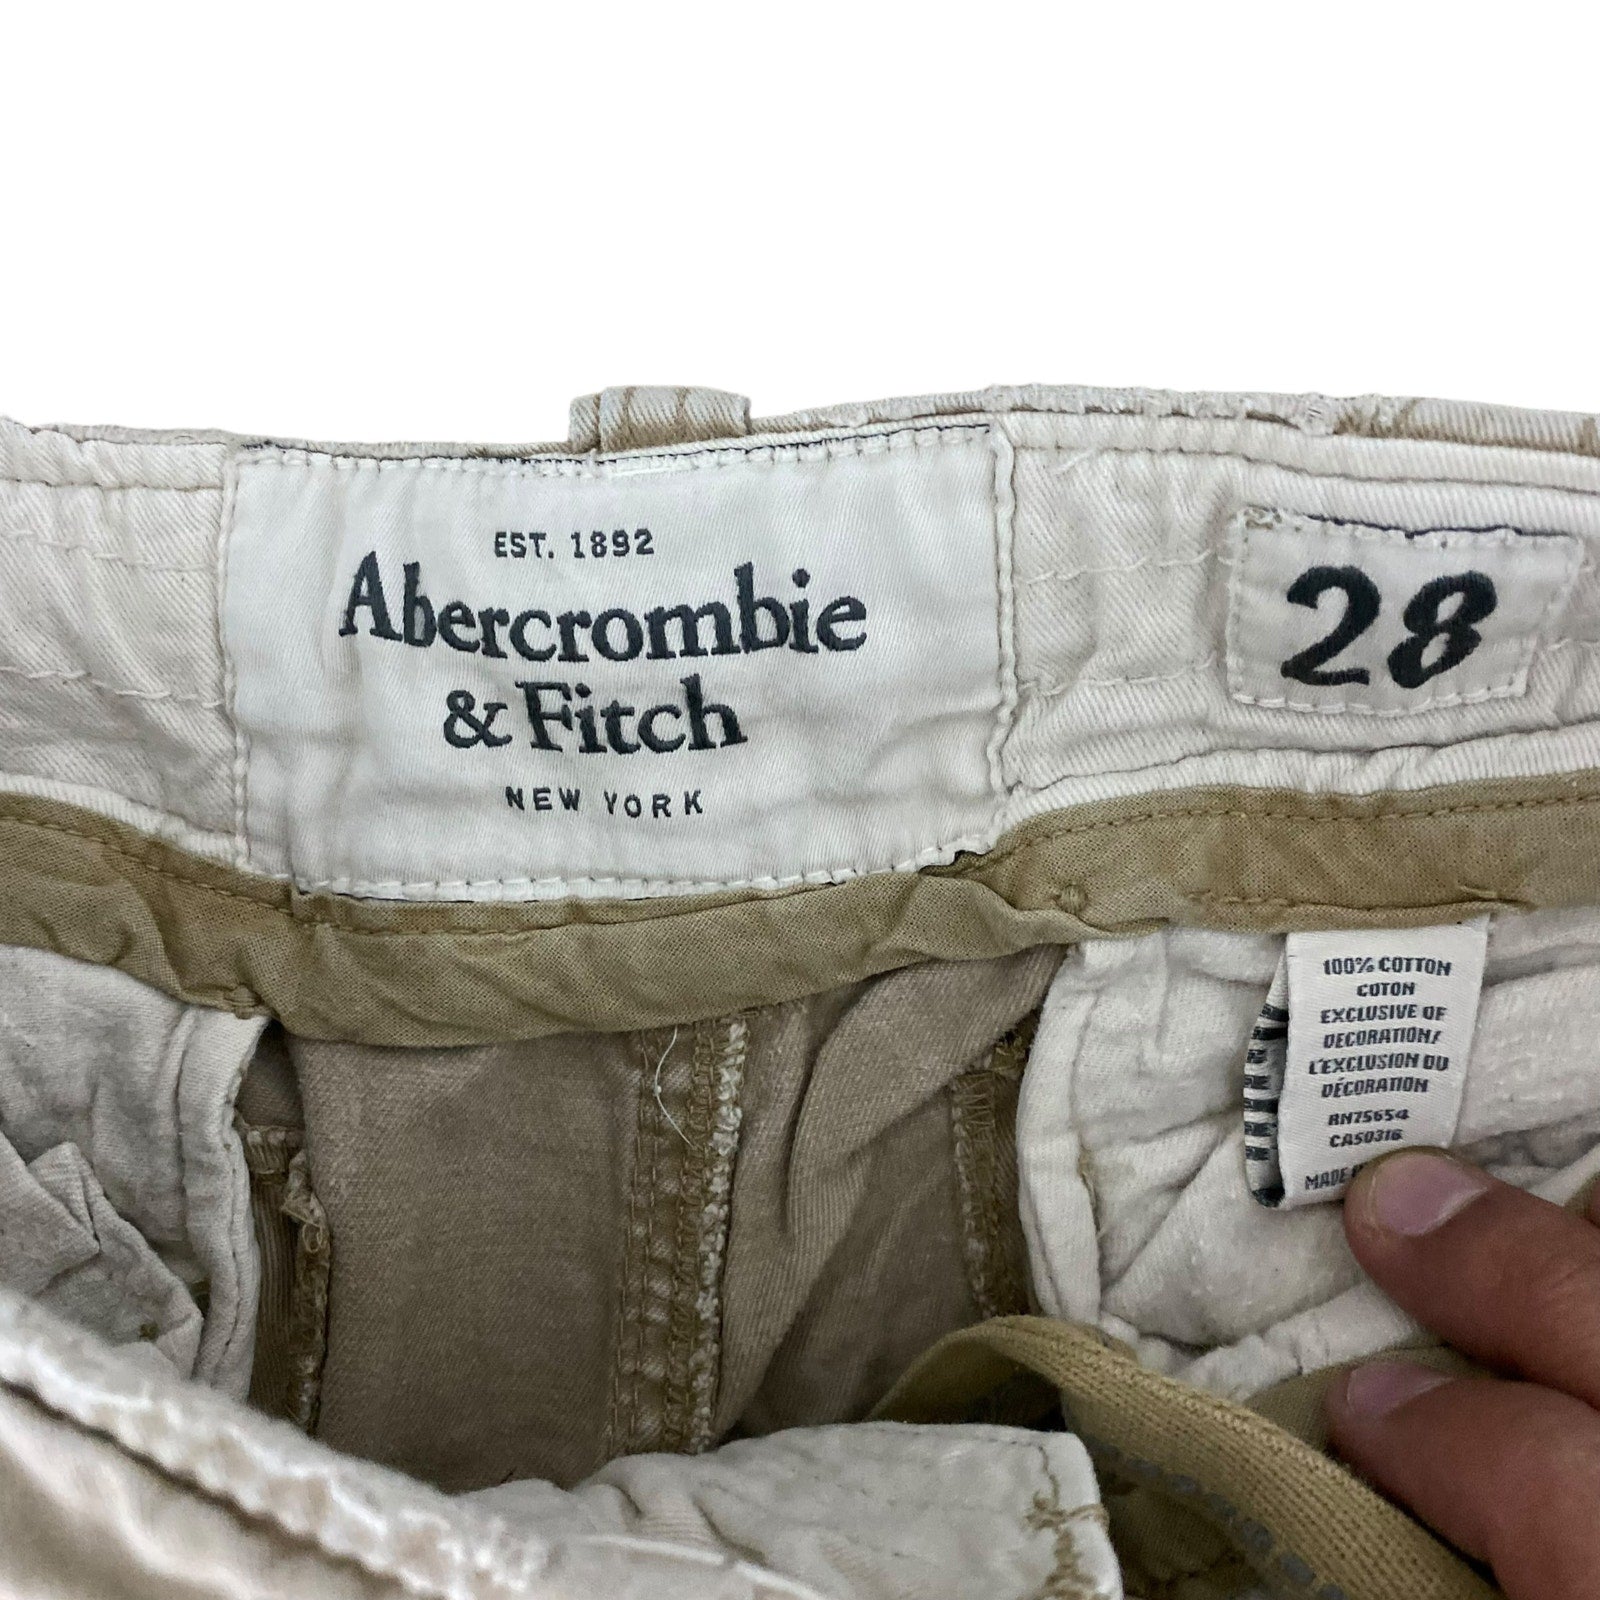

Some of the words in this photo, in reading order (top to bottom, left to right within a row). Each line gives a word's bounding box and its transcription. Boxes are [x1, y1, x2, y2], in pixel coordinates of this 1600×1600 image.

[494, 531, 554, 559] EST.
[570, 528, 654, 559] 1892
[339, 550, 867, 662] Abercrombie
[1281, 565, 1498, 689] 28
[443, 689, 512, 748] &
[515, 673, 747, 754] Fitch
[505, 786, 581, 811] NEW
[603, 789, 703, 818] YORK
[1323, 957, 1375, 976] 100%
[1379, 957, 1451, 976] COTTON
[1356, 981, 1416, 998] COTON
[1320, 1004, 1418, 1024] EXCLUSIVE
[1422, 1006, 1448, 1021] OF
[1308, 1052, 1418, 1075] L'EXCLUSION
[1423, 1055, 1449, 1071] DU
[1321, 1076, 1429, 1098] DÉCORATION
[1328, 1108, 1410, 1126] RN75654
[1329, 1129, 1402, 1147] CA50316
[1304, 1167, 1347, 1191] MADE
